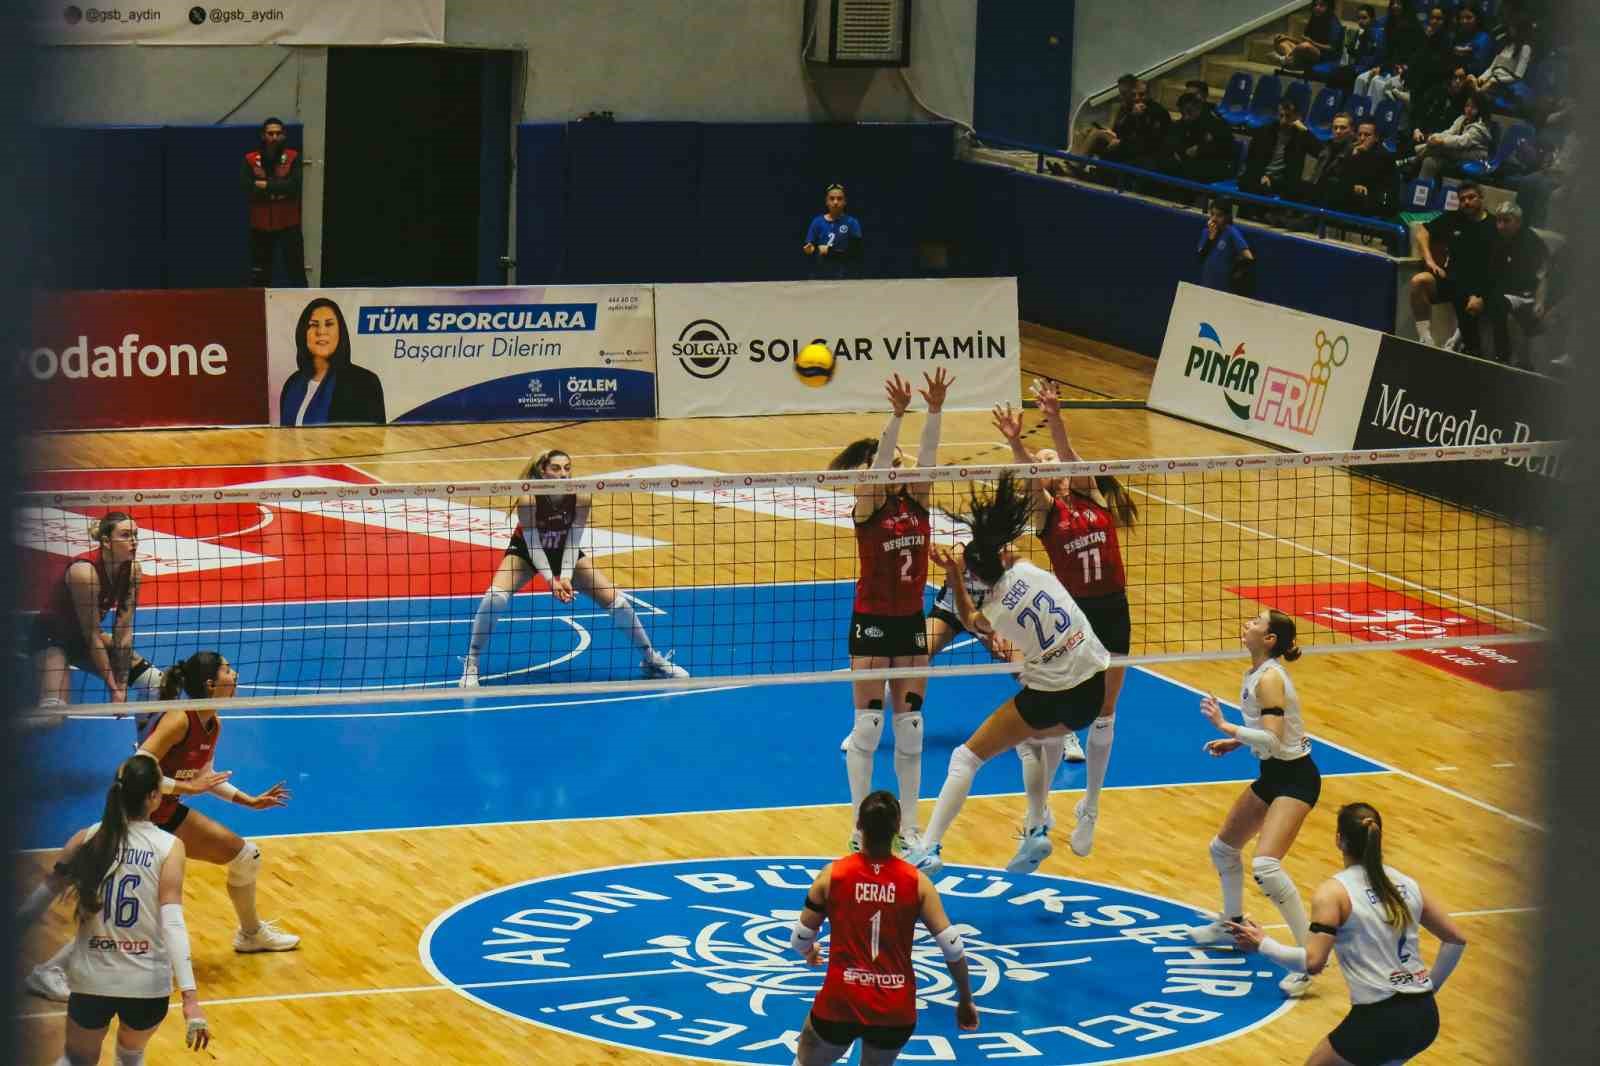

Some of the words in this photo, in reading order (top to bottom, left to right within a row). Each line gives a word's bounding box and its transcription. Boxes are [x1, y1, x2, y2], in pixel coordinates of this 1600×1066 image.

[85, 8, 161, 24] @gsb_aydin
[209, 8, 284, 24] @gsb_aydin
[366, 308, 419, 332] TÜM
[427, 311, 587, 331] SPORCULARA
[30, 333, 228, 380] odafone
[393, 335, 485, 363] Başarılar
[491, 334, 562, 358] Dilerim
[672, 342, 738, 356] SOLGAR
[749, 338, 873, 362] SOLAR
[882, 329, 1007, 361] VİTAMİN
[566, 376, 618, 392] ÖZLEM
[1371, 383, 1503, 449] Mercedes
[899, 549, 913, 581] 2
[1078, 548, 1102, 584] 11
[1002, 579, 1030, 611] SEHER
[1017, 590, 1071, 650] 23
[103, 873, 141, 928] 16
[855, 882, 897, 904] ÇERAĞ
[482, 884, 673, 968] AYDIN
[674, 864, 1273, 997] BÜÜKŞEHİR
[869, 910, 881, 962] 1
[843, 970, 905, 985] SPORTOTO
